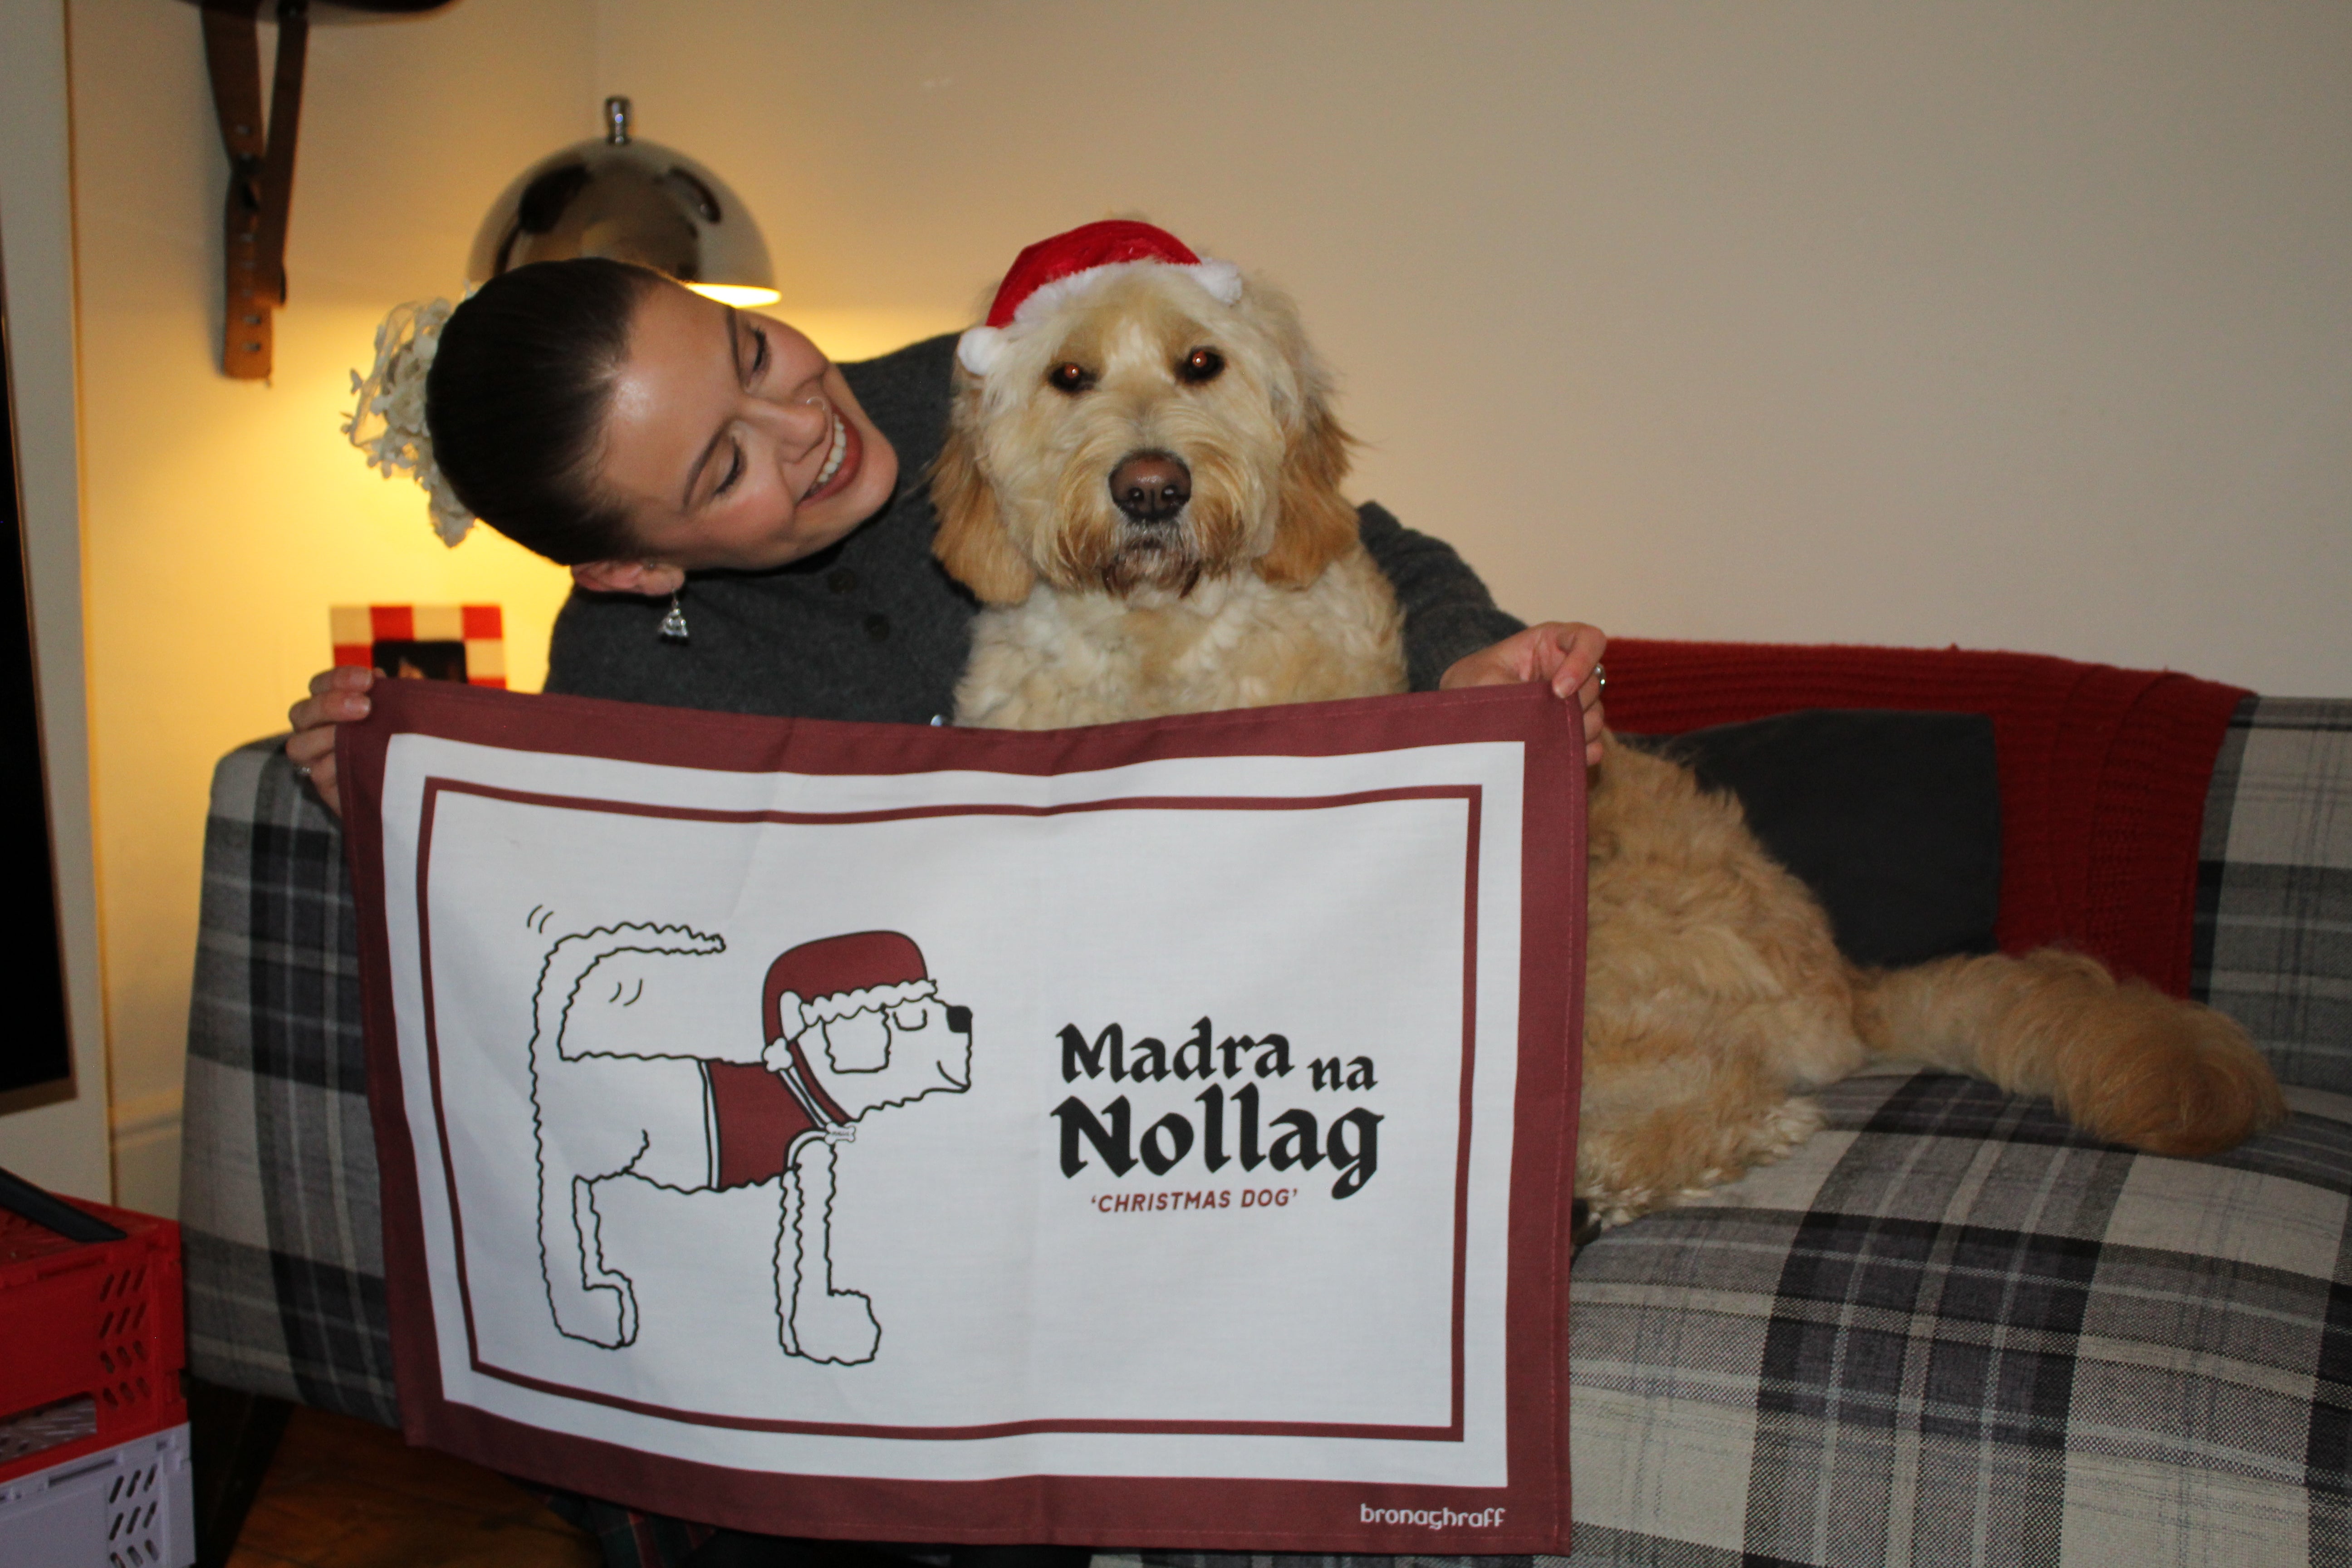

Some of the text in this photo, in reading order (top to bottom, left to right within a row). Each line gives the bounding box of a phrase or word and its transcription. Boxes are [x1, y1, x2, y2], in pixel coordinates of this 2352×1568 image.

[1055, 1015, 1379, 1092] Madra na
[1050, 1082, 1385, 1200] Nollag
[1360, 1503, 1506, 1530] bronaghraff
